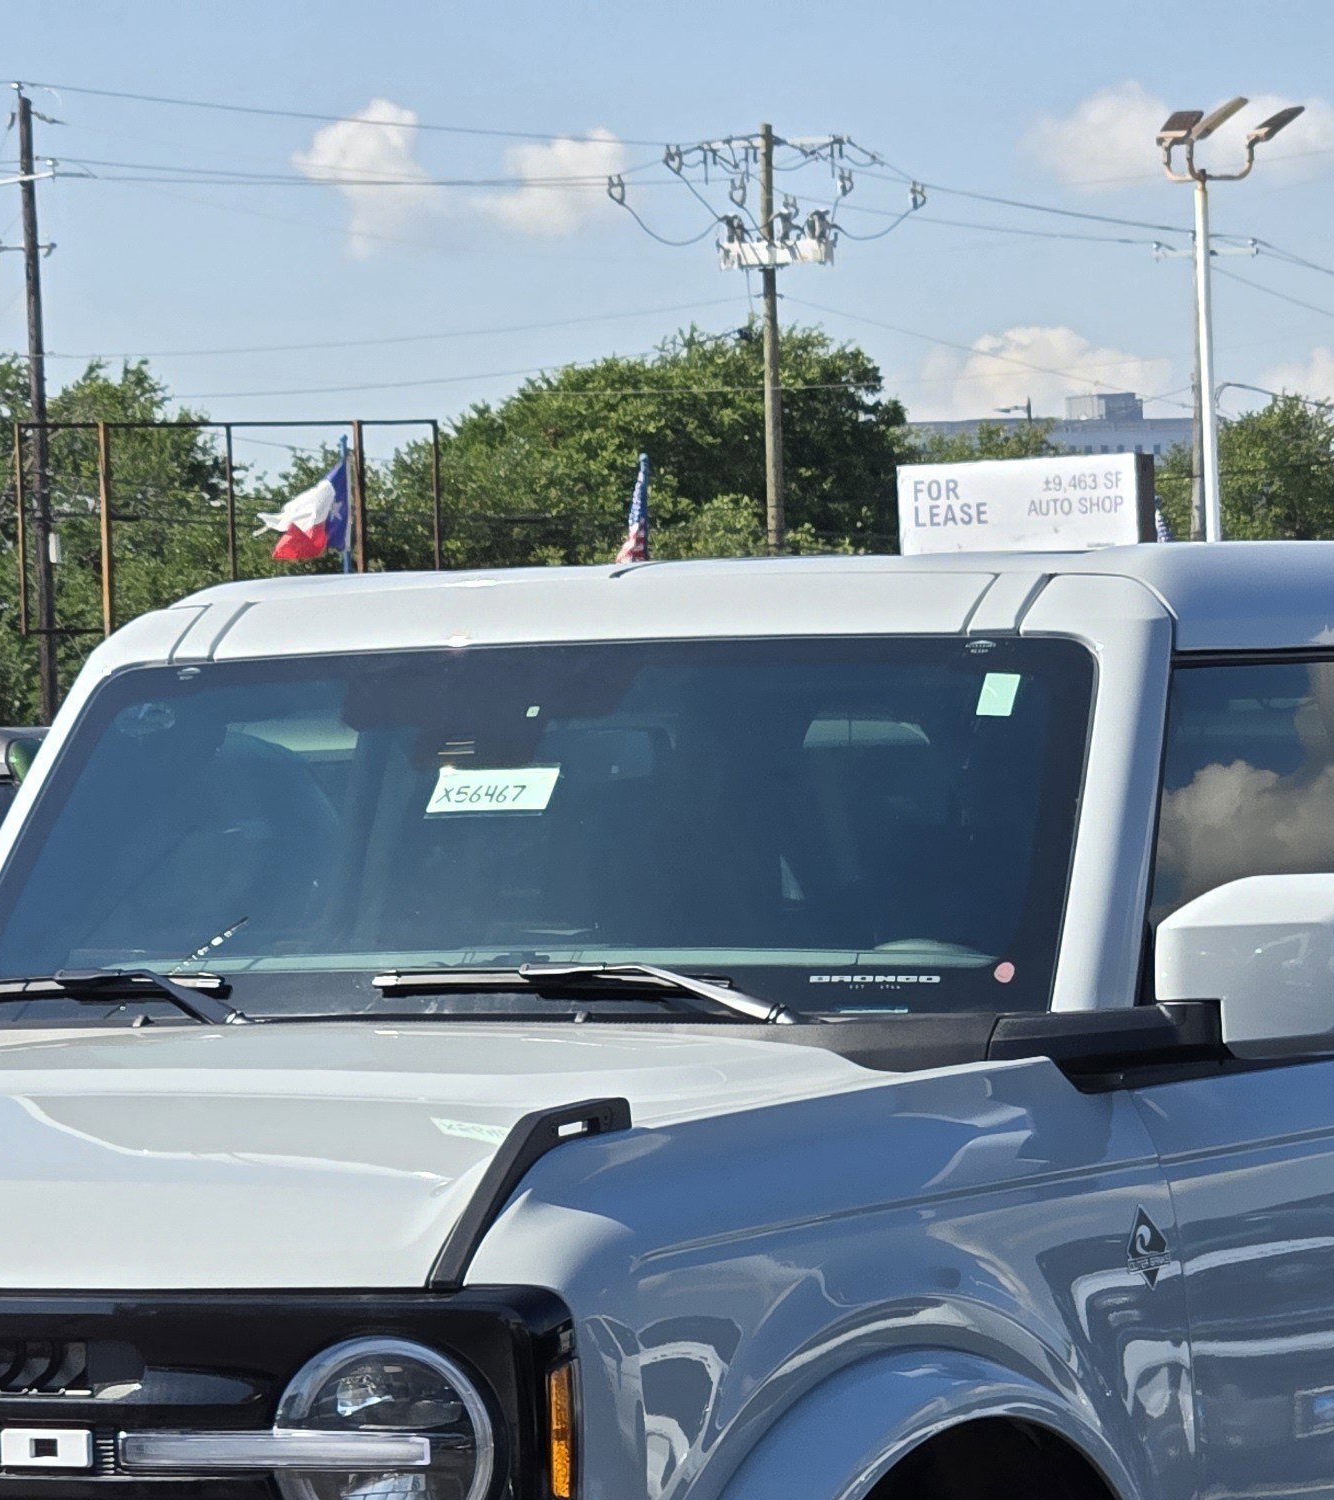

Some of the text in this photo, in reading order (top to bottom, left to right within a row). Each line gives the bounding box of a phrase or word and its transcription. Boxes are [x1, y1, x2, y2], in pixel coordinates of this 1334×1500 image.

[913, 479, 959, 501] FOR
[1043, 471, 1122, 494] ±9,463 SF
[913, 502, 988, 527] LEASE
[1027, 495, 1124, 517] AUTO SHOP
[435, 785, 527, 803] X56467
